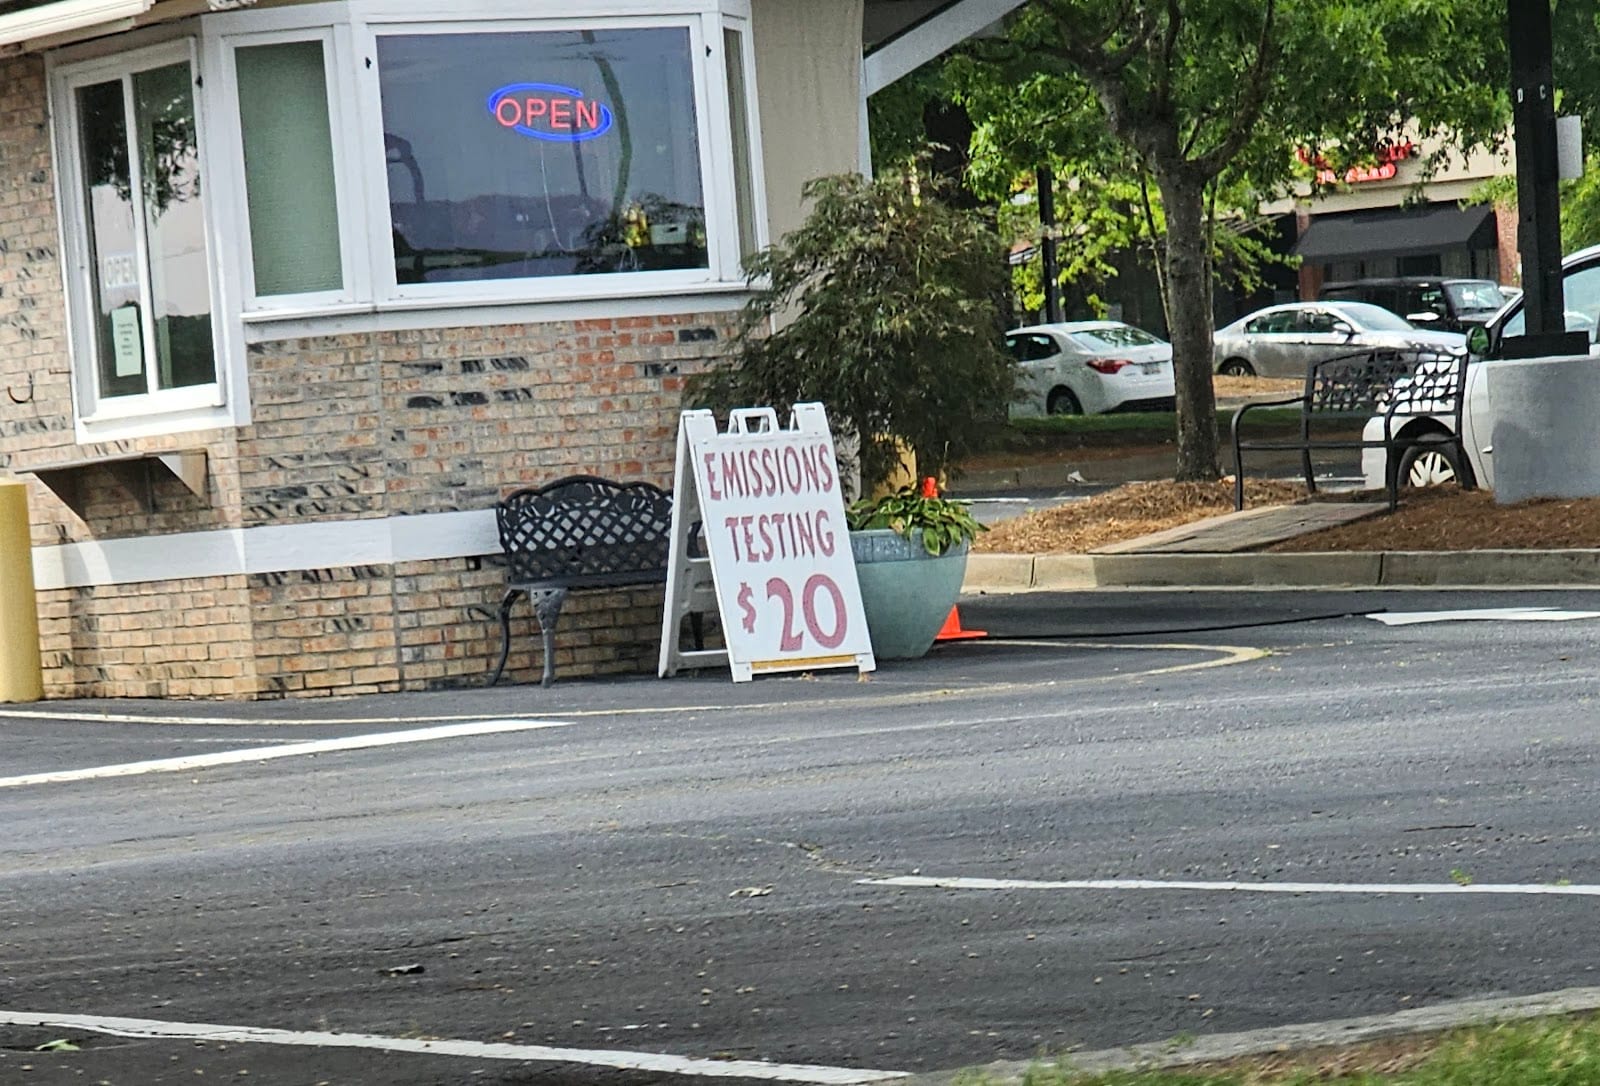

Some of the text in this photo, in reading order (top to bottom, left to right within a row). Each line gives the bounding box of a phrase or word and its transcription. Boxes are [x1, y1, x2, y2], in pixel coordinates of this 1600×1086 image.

[496, 98, 598, 129] OPEN
[704, 443, 832, 501] EMISSIONS
[725, 509, 835, 564] TESTING
